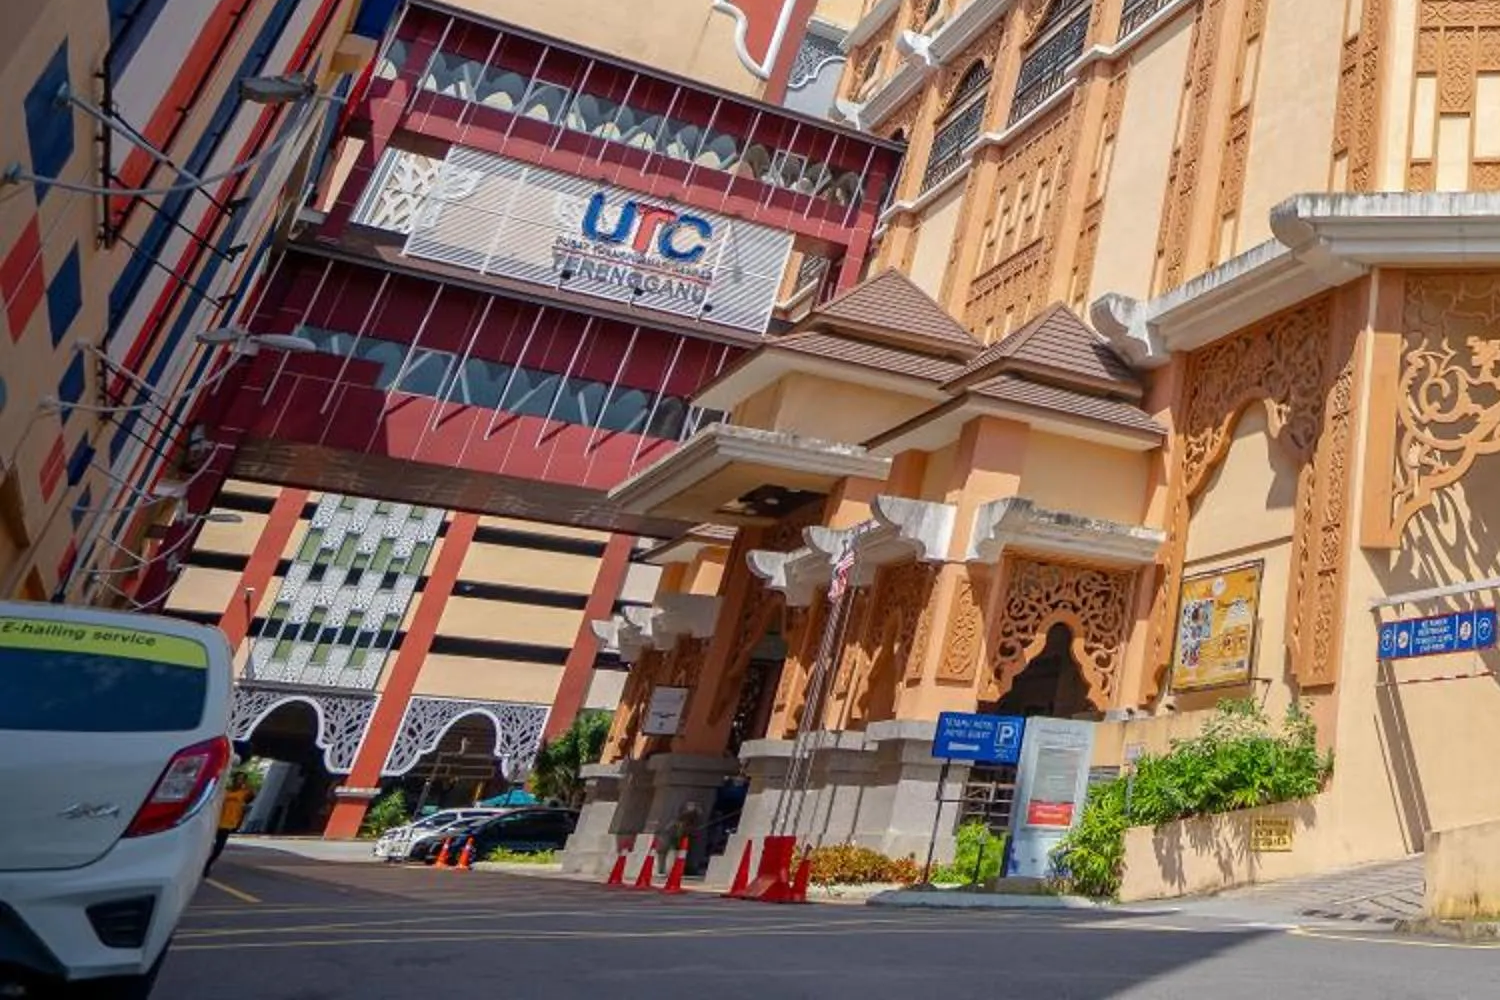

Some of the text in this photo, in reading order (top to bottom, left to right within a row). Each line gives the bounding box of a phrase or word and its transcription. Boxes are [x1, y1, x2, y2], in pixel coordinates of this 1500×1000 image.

[582, 192, 713, 263] UTC
[553, 250, 707, 303] TERENGGANU
[2, 621, 157, 647] E-hailing service
[999, 725, 1014, 742] P
